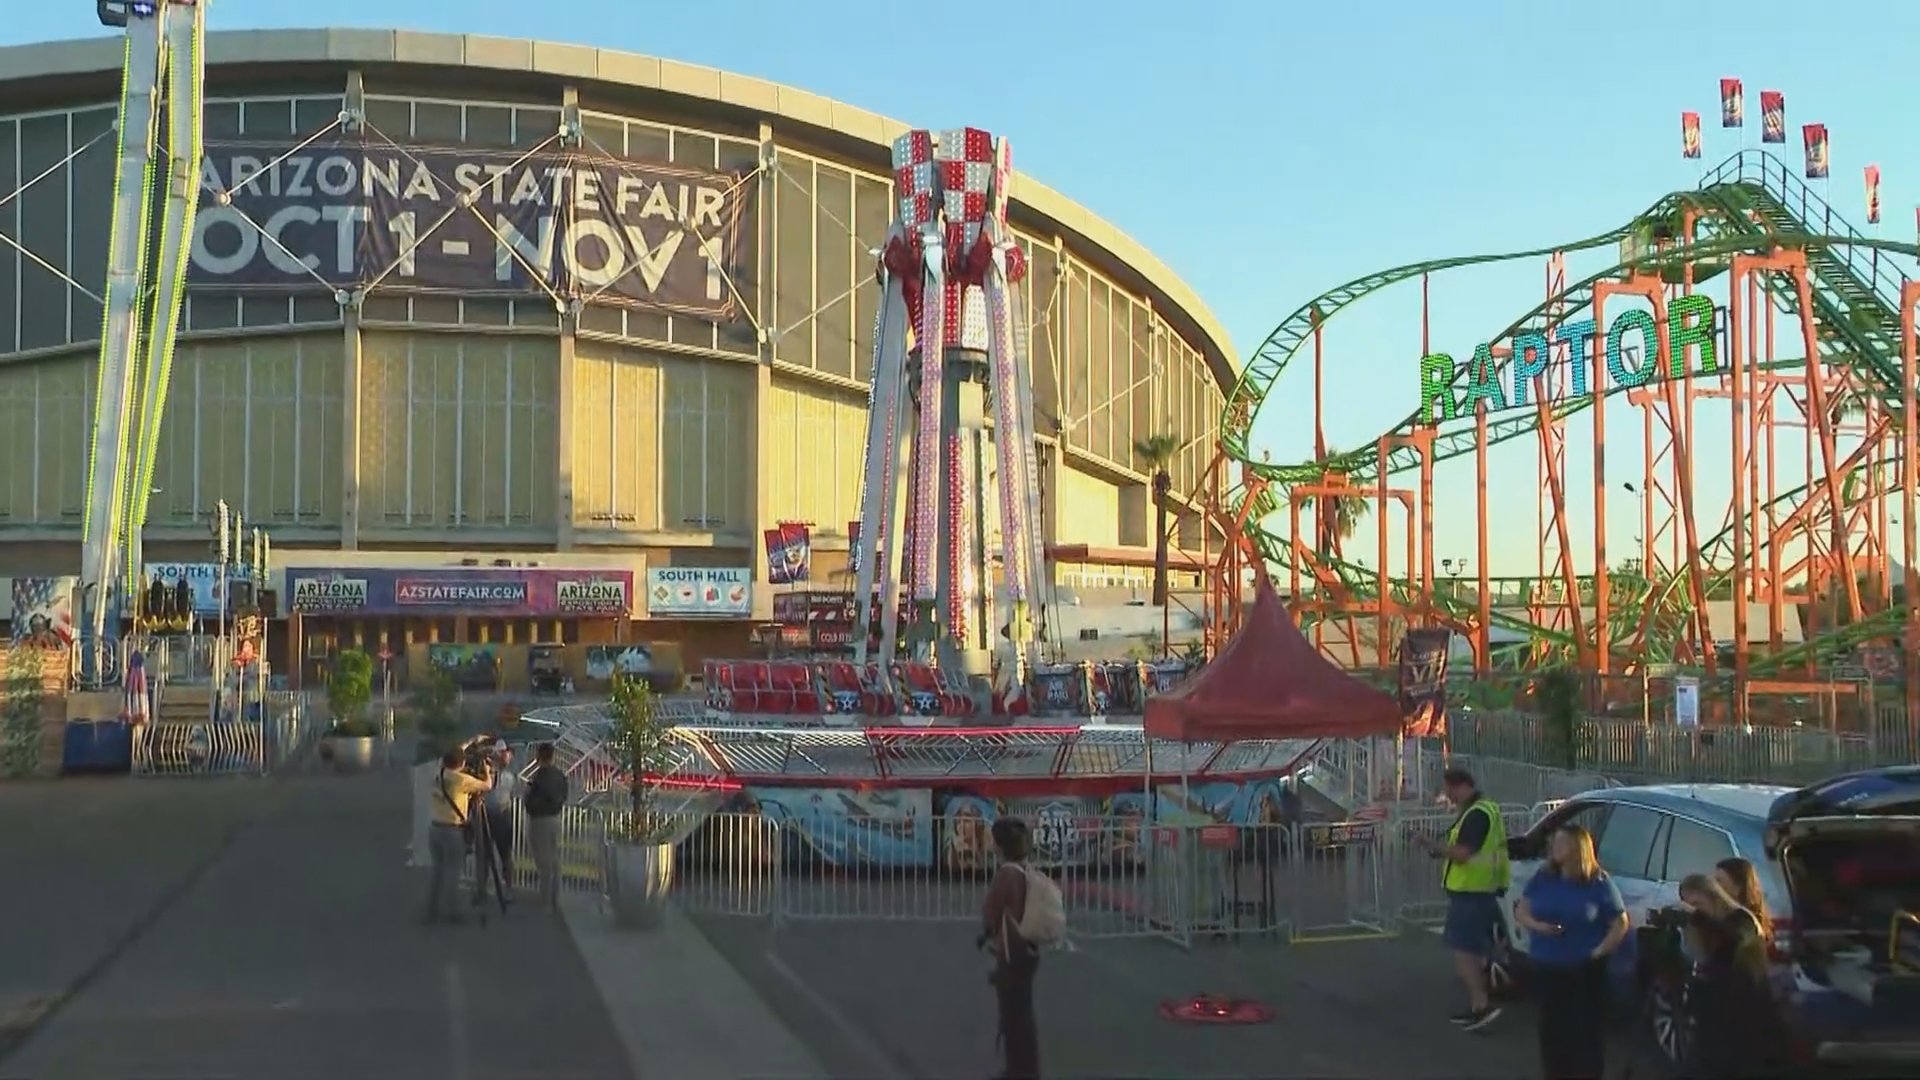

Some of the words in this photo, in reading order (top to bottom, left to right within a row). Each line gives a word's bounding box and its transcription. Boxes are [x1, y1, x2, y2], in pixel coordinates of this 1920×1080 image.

[200, 155, 441, 201] ARIZONA
[454, 163, 601, 212] STATE
[615, 174, 725, 227] FAIR
[190, 204, 372, 274] OCT
[388, 211, 416, 277] 1
[496, 212, 685, 294] NOV
[698, 236, 724, 301] 1
[1420, 295, 1719, 424] RAPTOR
[658, 571, 703, 581] SOUTH
[707, 571, 740, 582] HALL
[297, 583, 364, 597] ARIZONA
[399, 586, 525, 599] AZSTATEFAIR.COM
[560, 585, 622, 598] ARIZONA
